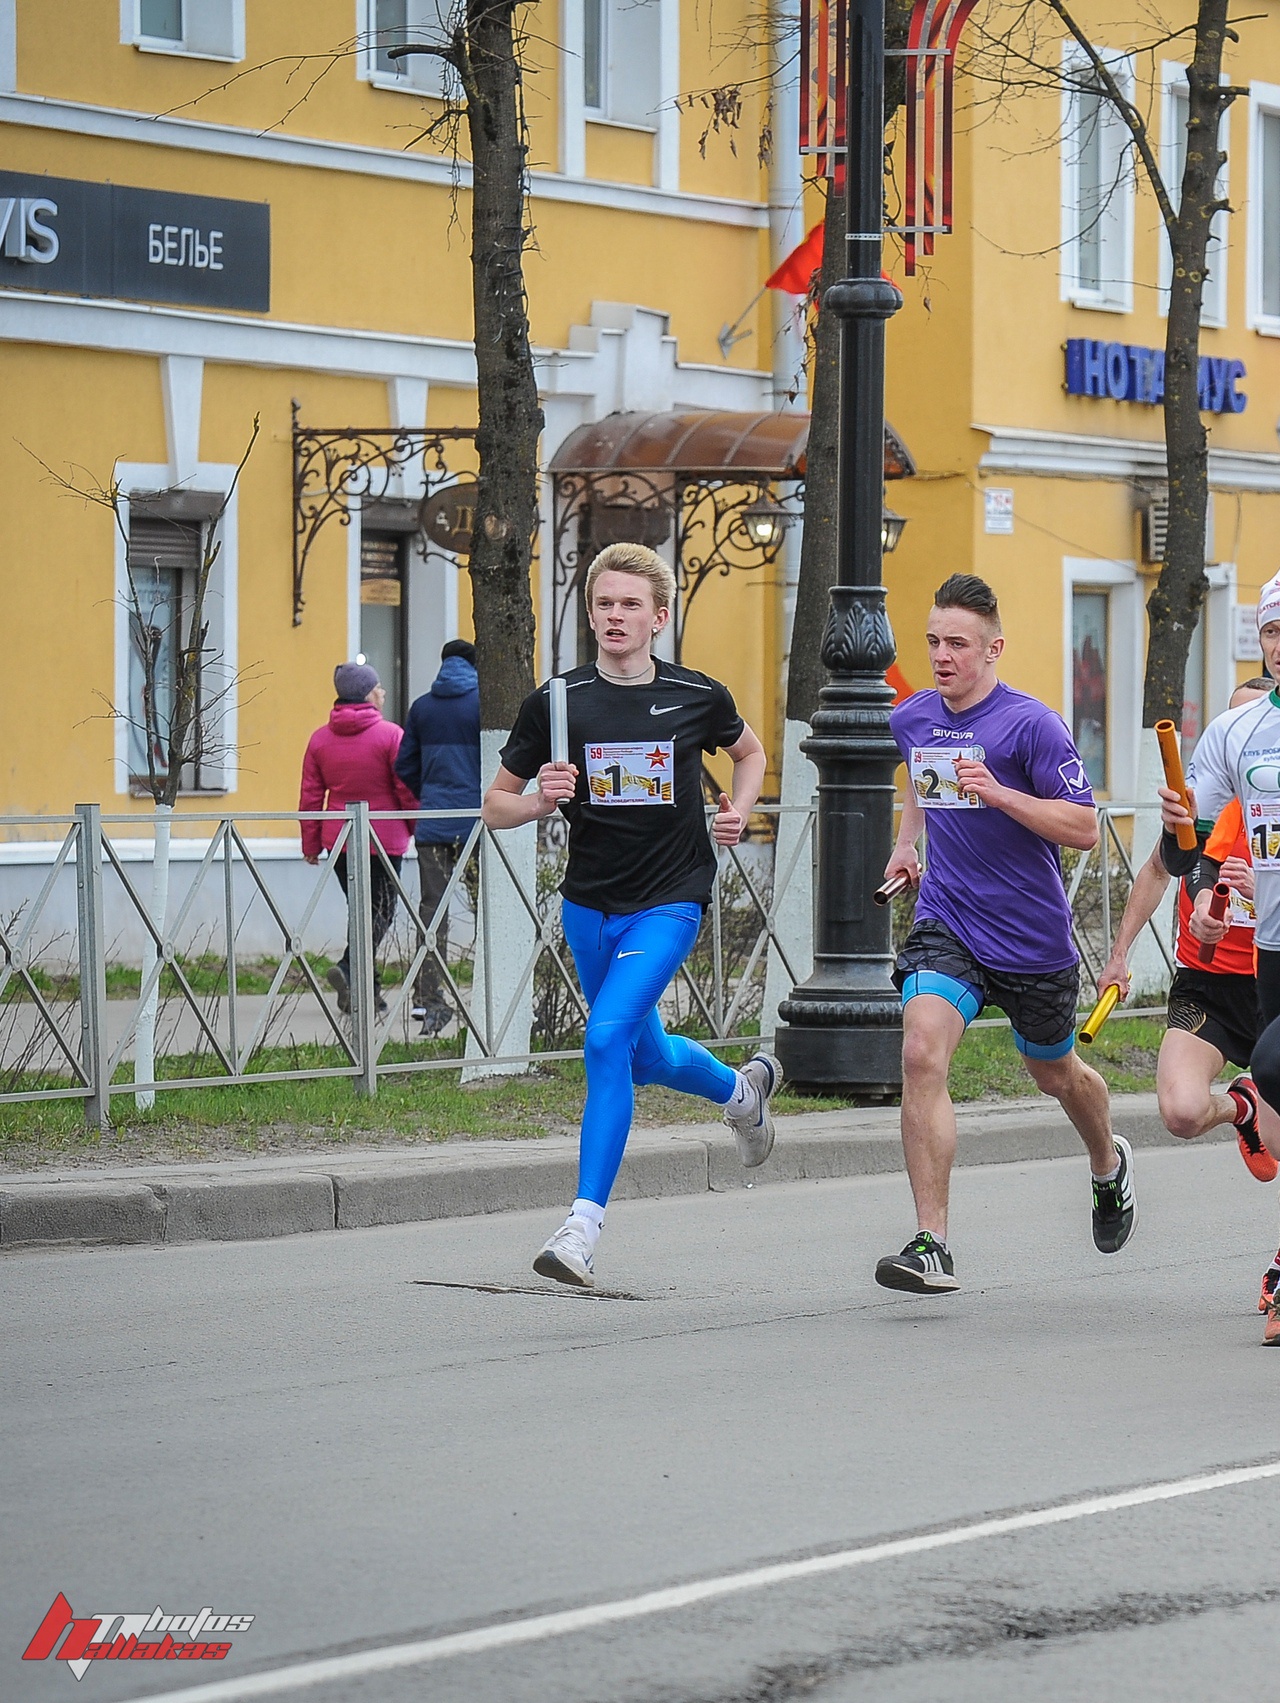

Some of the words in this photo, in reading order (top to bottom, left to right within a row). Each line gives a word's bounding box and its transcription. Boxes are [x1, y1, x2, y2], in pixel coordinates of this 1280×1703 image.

[149, 223, 224, 270] БЕЛЬЕ
[1074, 339, 1247, 413] НОТАИУС
[590, 747, 602, 759] 59
[604, 765, 621, 796] 1
[652, 776, 661, 794] 1
[922, 768, 941, 799] 2
[1250, 803, 1261, 817] 59
